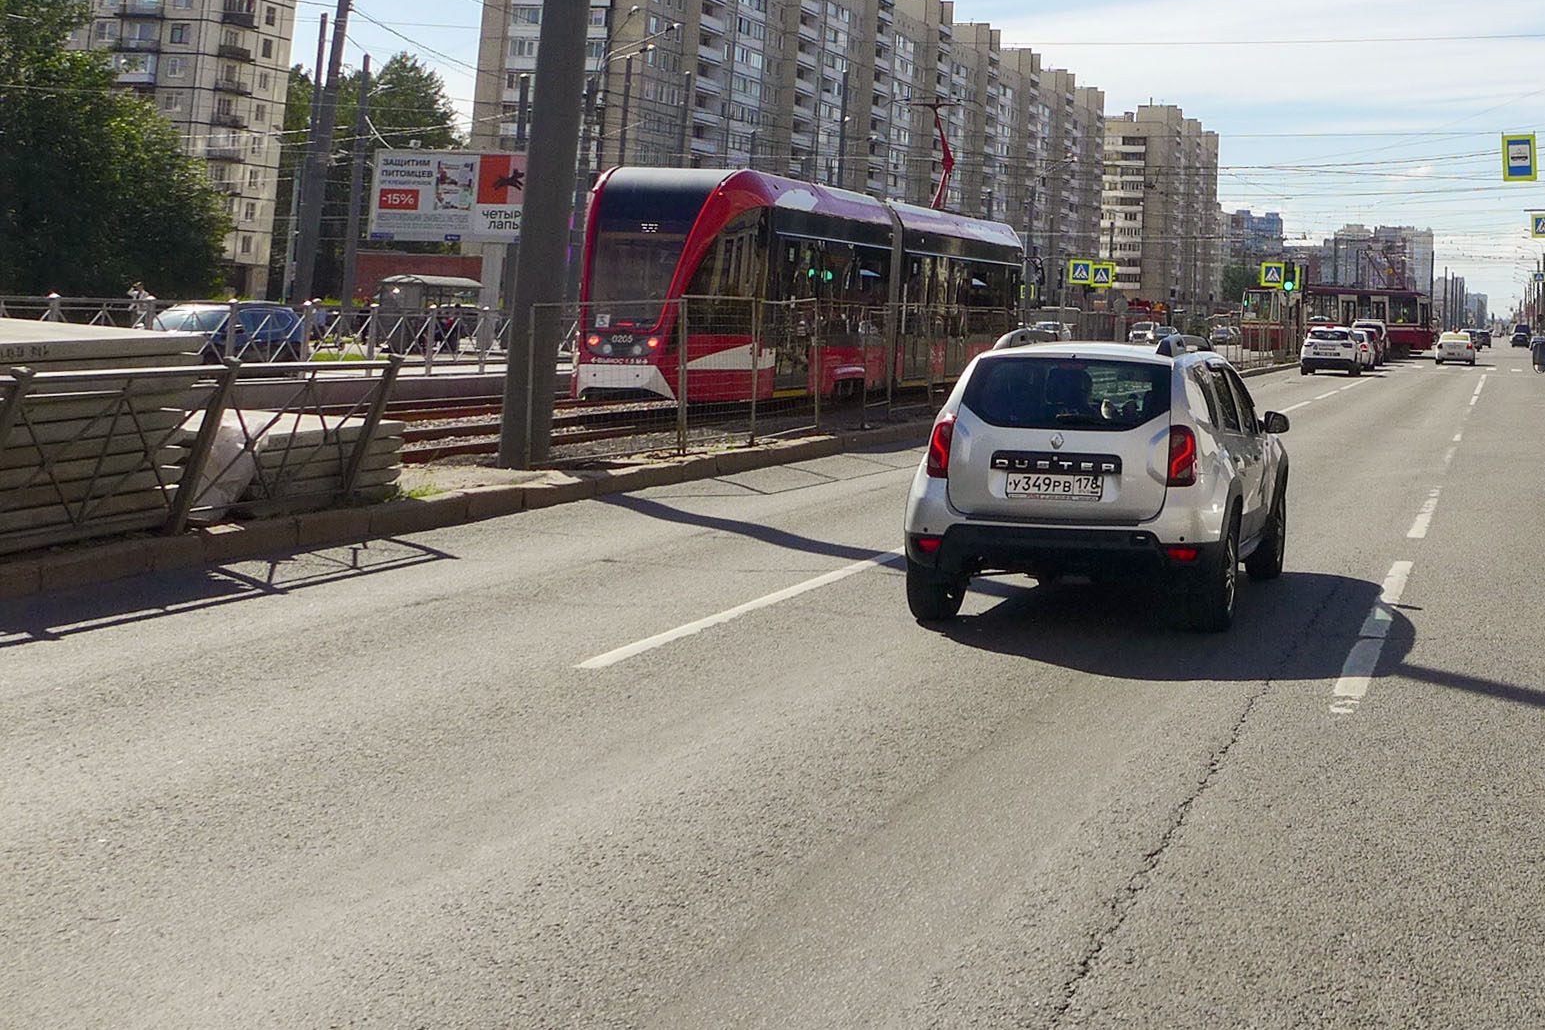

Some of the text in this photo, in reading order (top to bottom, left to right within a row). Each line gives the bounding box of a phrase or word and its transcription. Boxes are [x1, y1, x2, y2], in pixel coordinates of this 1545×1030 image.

[381, 170, 434, 179] ПИТОМЦЕВ
[381, 193, 415, 205] -15%
[482, 210, 522, 219] четыр
[995, 458, 1115, 472] DUSTER
